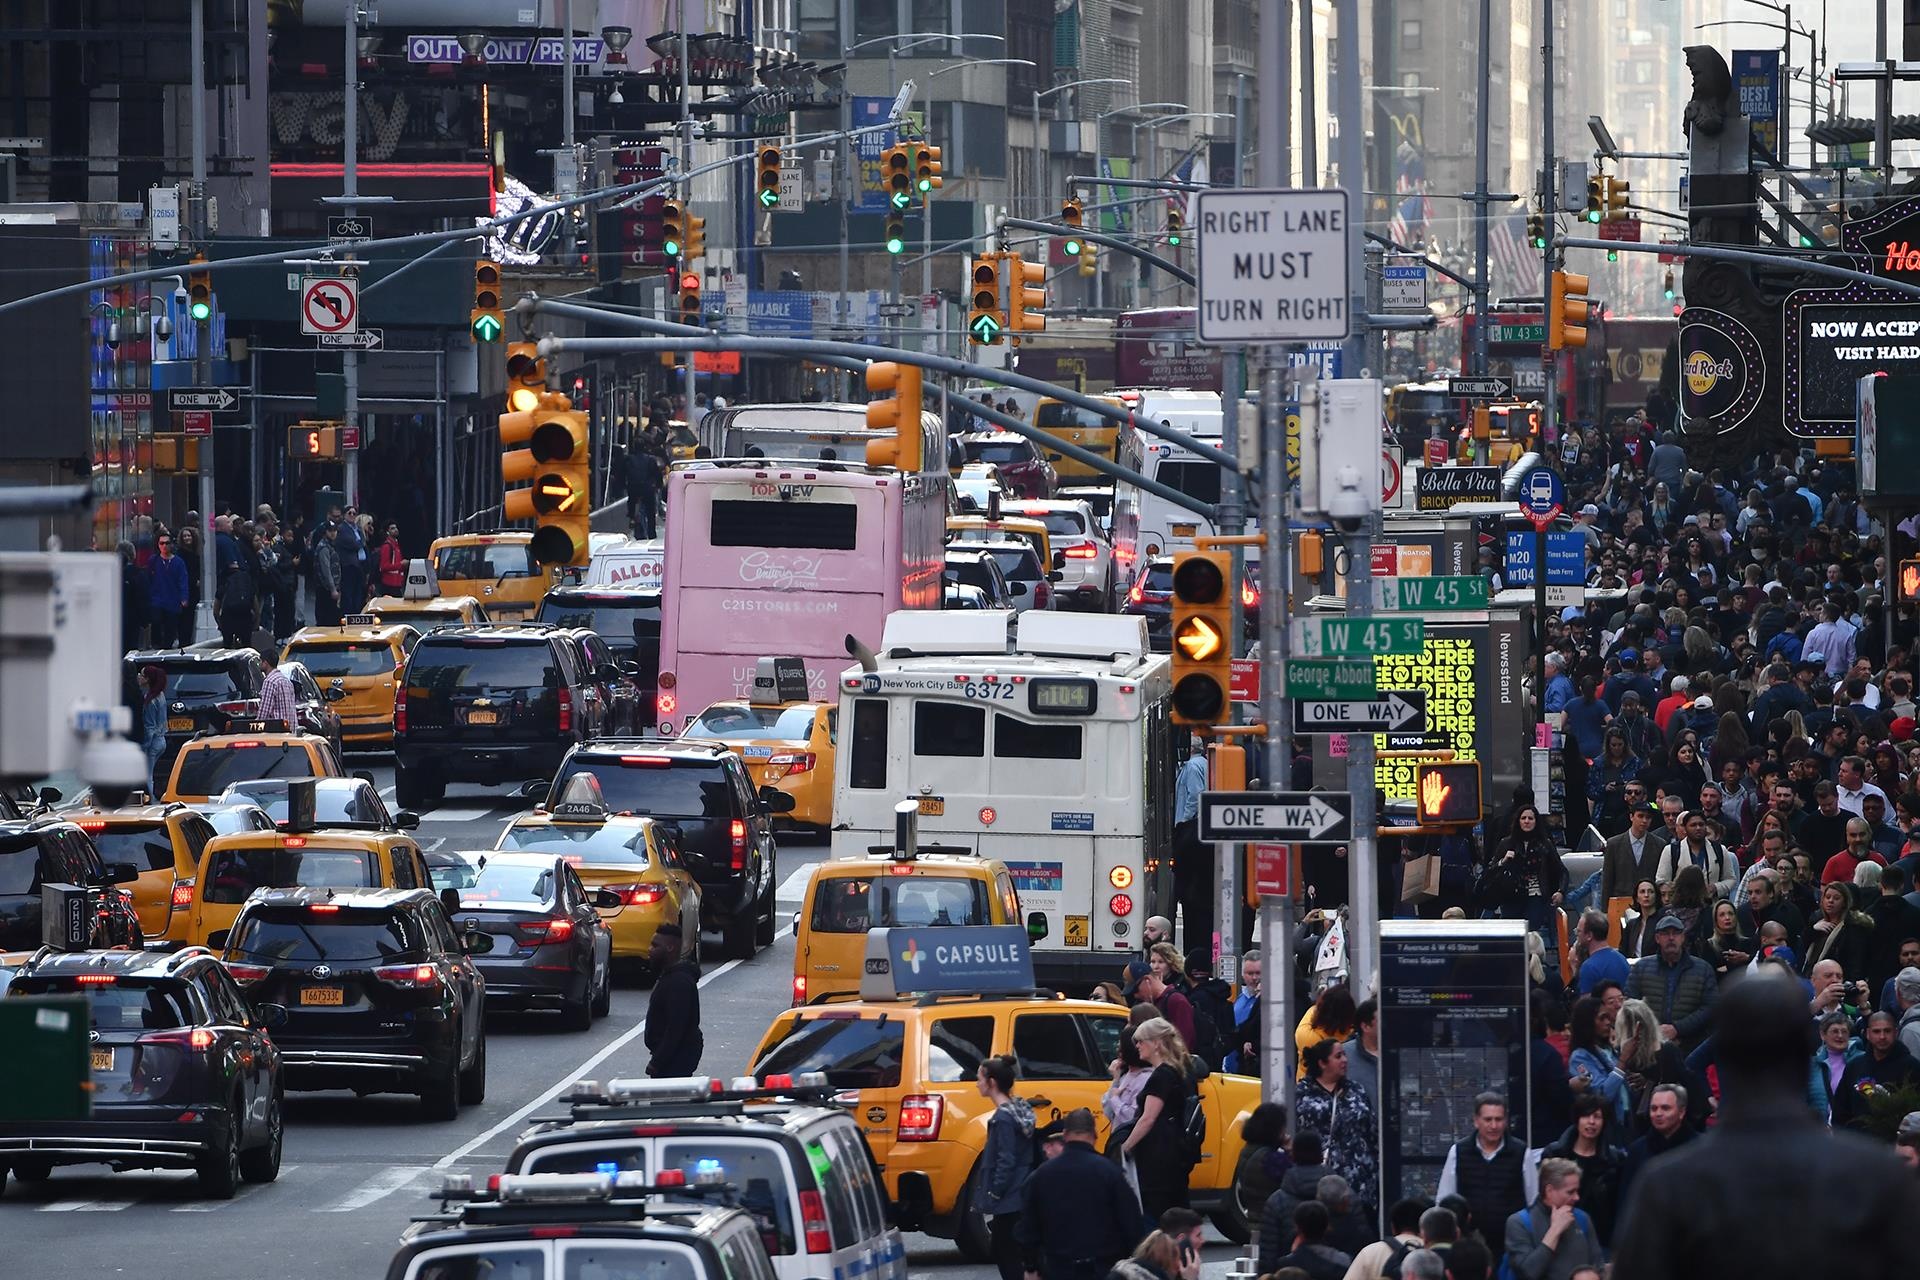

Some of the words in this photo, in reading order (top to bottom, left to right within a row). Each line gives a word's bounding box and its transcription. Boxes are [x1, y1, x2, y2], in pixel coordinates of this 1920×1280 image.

[413, 39, 527, 59] OUTONT
[540, 43, 598, 60] PRME
[1740, 86, 1769, 102] BEST
[861, 132, 885, 145] TRUE
[153, 208, 175, 218] 726153
[1204, 211, 1270, 233] RIGHT
[1284, 210, 1341, 232] LANE
[1234, 252, 1312, 279] MUST
[1385, 269, 1397, 277] US
[1399, 269, 1422, 277] LANE
[1205, 299, 1262, 321] TURN
[1277, 298, 1343, 320] RIGHT
[1121, 320, 1133, 328] 22
[1811, 322, 1858, 337] NOW
[323, 335, 343, 344] ONE
[353, 335, 374, 344] WAY
[1503, 327, 1513, 339] W
[1517, 327, 1530, 339] 43
[1534, 327, 1543, 336] St
[1834, 347, 1874, 360] VISIT
[1876, 346, 1920, 360] HARD
[1699, 358, 1733, 379] Rock
[1457, 384, 1475, 392] ONE
[1483, 384, 1503, 392] WAY
[179, 395, 199, 404] ONE
[207, 395, 229, 404] WAY
[1421, 472, 1461, 491] Bella
[1465, 472, 1496, 490] Vita
[1421, 496, 1446, 508] BRICK
[1521, 506, 1532, 517] NO
[1531, 508, 1560, 521] STANDING
[1509, 534, 1523, 547] M7
[1509, 551, 1530, 564] M20
[1562, 551, 1579, 559] Square
[611, 563, 662, 585] ALLCO
[740, 551, 793, 591] Century
[793, 558, 823, 576] 21
[1509, 568, 1534, 581] M104
[1562, 569, 1574, 577] Ferry
[1404, 582, 1423, 605] W
[1434, 581, 1459, 605] 45
[1469, 580, 1483, 595] St
[1327, 624, 1349, 650] W
[1363, 623, 1392, 650] 45
[1403, 623, 1419, 640] St
[1435, 648, 1475, 665] FREE
[1231, 664, 1253, 672] TANDING
[1412, 665, 1455, 683] FREE
[1500, 633, 1512, 704] Newsstand
[1289, 665, 1329, 688] George
[1334, 664, 1372, 684] Abbott
[863, 678, 879, 688] MTA
[883, 679, 903, 688] New
[904, 679, 924, 688] York
[926, 680, 945, 690] City
[947, 680, 964, 690] Bus
[964, 682, 1015, 700] 6372
[1435, 682, 1475, 699] FREE
[1324, 686, 1337, 698] Way
[1313, 704, 1350, 719] ONE
[1368, 704, 1406, 719] WAY
[1426, 699, 1455, 716] REE
[1460, 703, 1470, 711] TV
[1436, 715, 1476, 732] FREE
[1391, 737, 1413, 745] PLUTO
[1397, 770, 1409, 779] TV
[567, 805, 590, 814] 2A46
[1222, 807, 1265, 827] ONE
[1285, 807, 1329, 827] WAY
[935, 943, 1020, 965] CAPSULE
[1457, 943, 1479, 951] Street
[1420, 957, 1446, 965] Square
